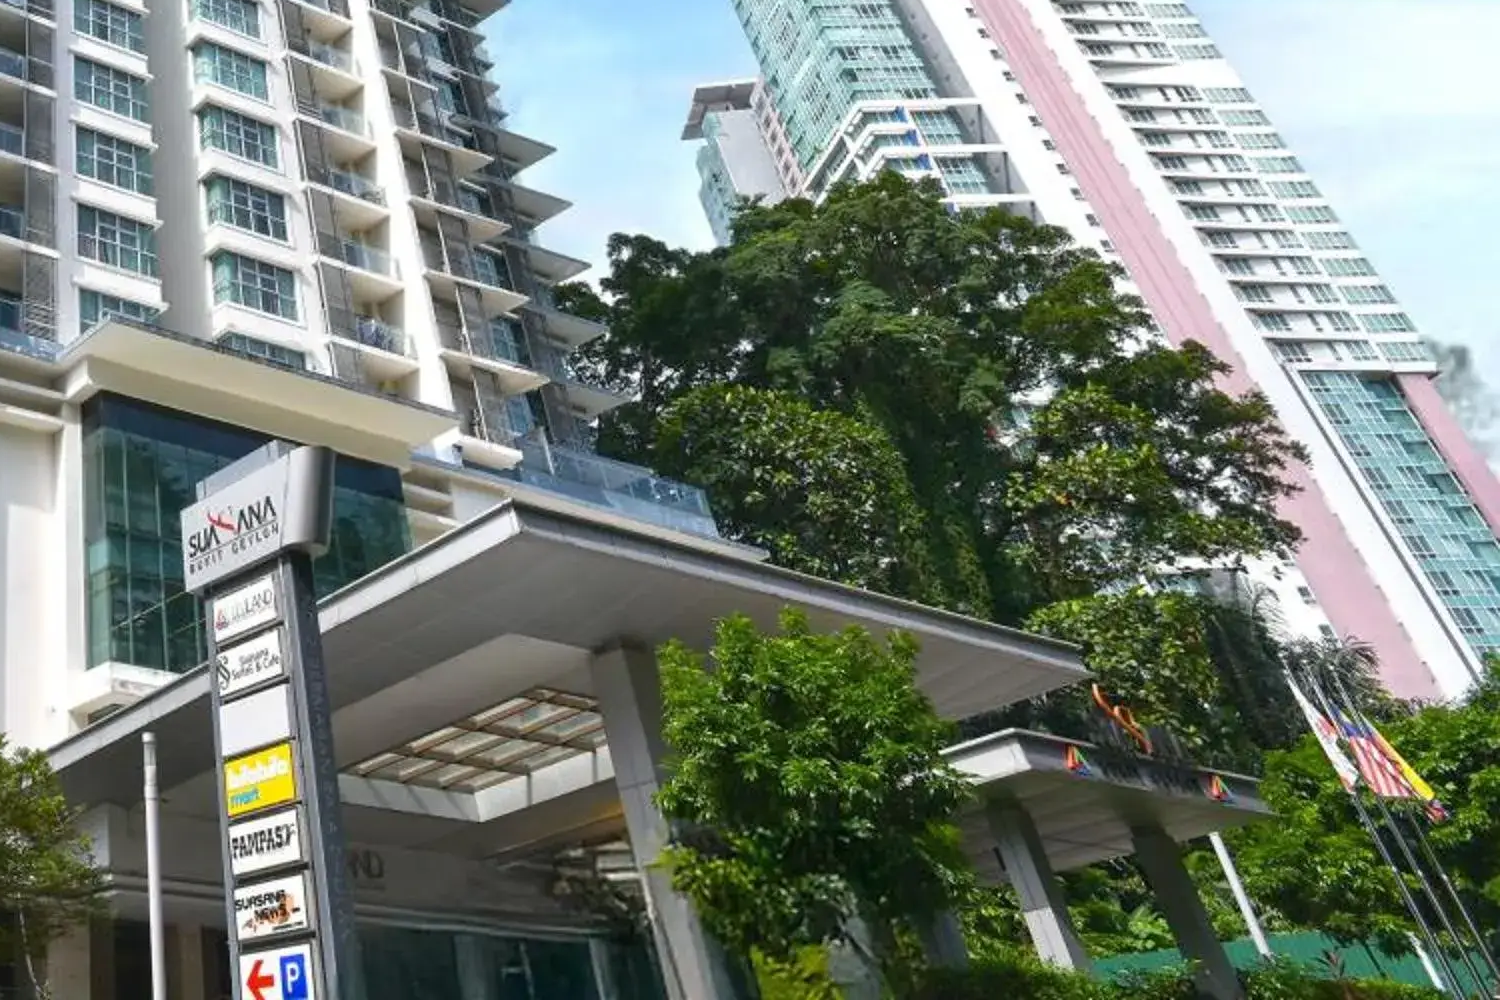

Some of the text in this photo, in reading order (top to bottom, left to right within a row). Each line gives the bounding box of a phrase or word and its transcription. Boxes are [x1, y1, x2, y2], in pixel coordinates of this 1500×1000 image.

[231, 522, 279, 555] CEYLON
[231, 825, 284, 859] PAMPAS
[286, 962, 300, 994] P
